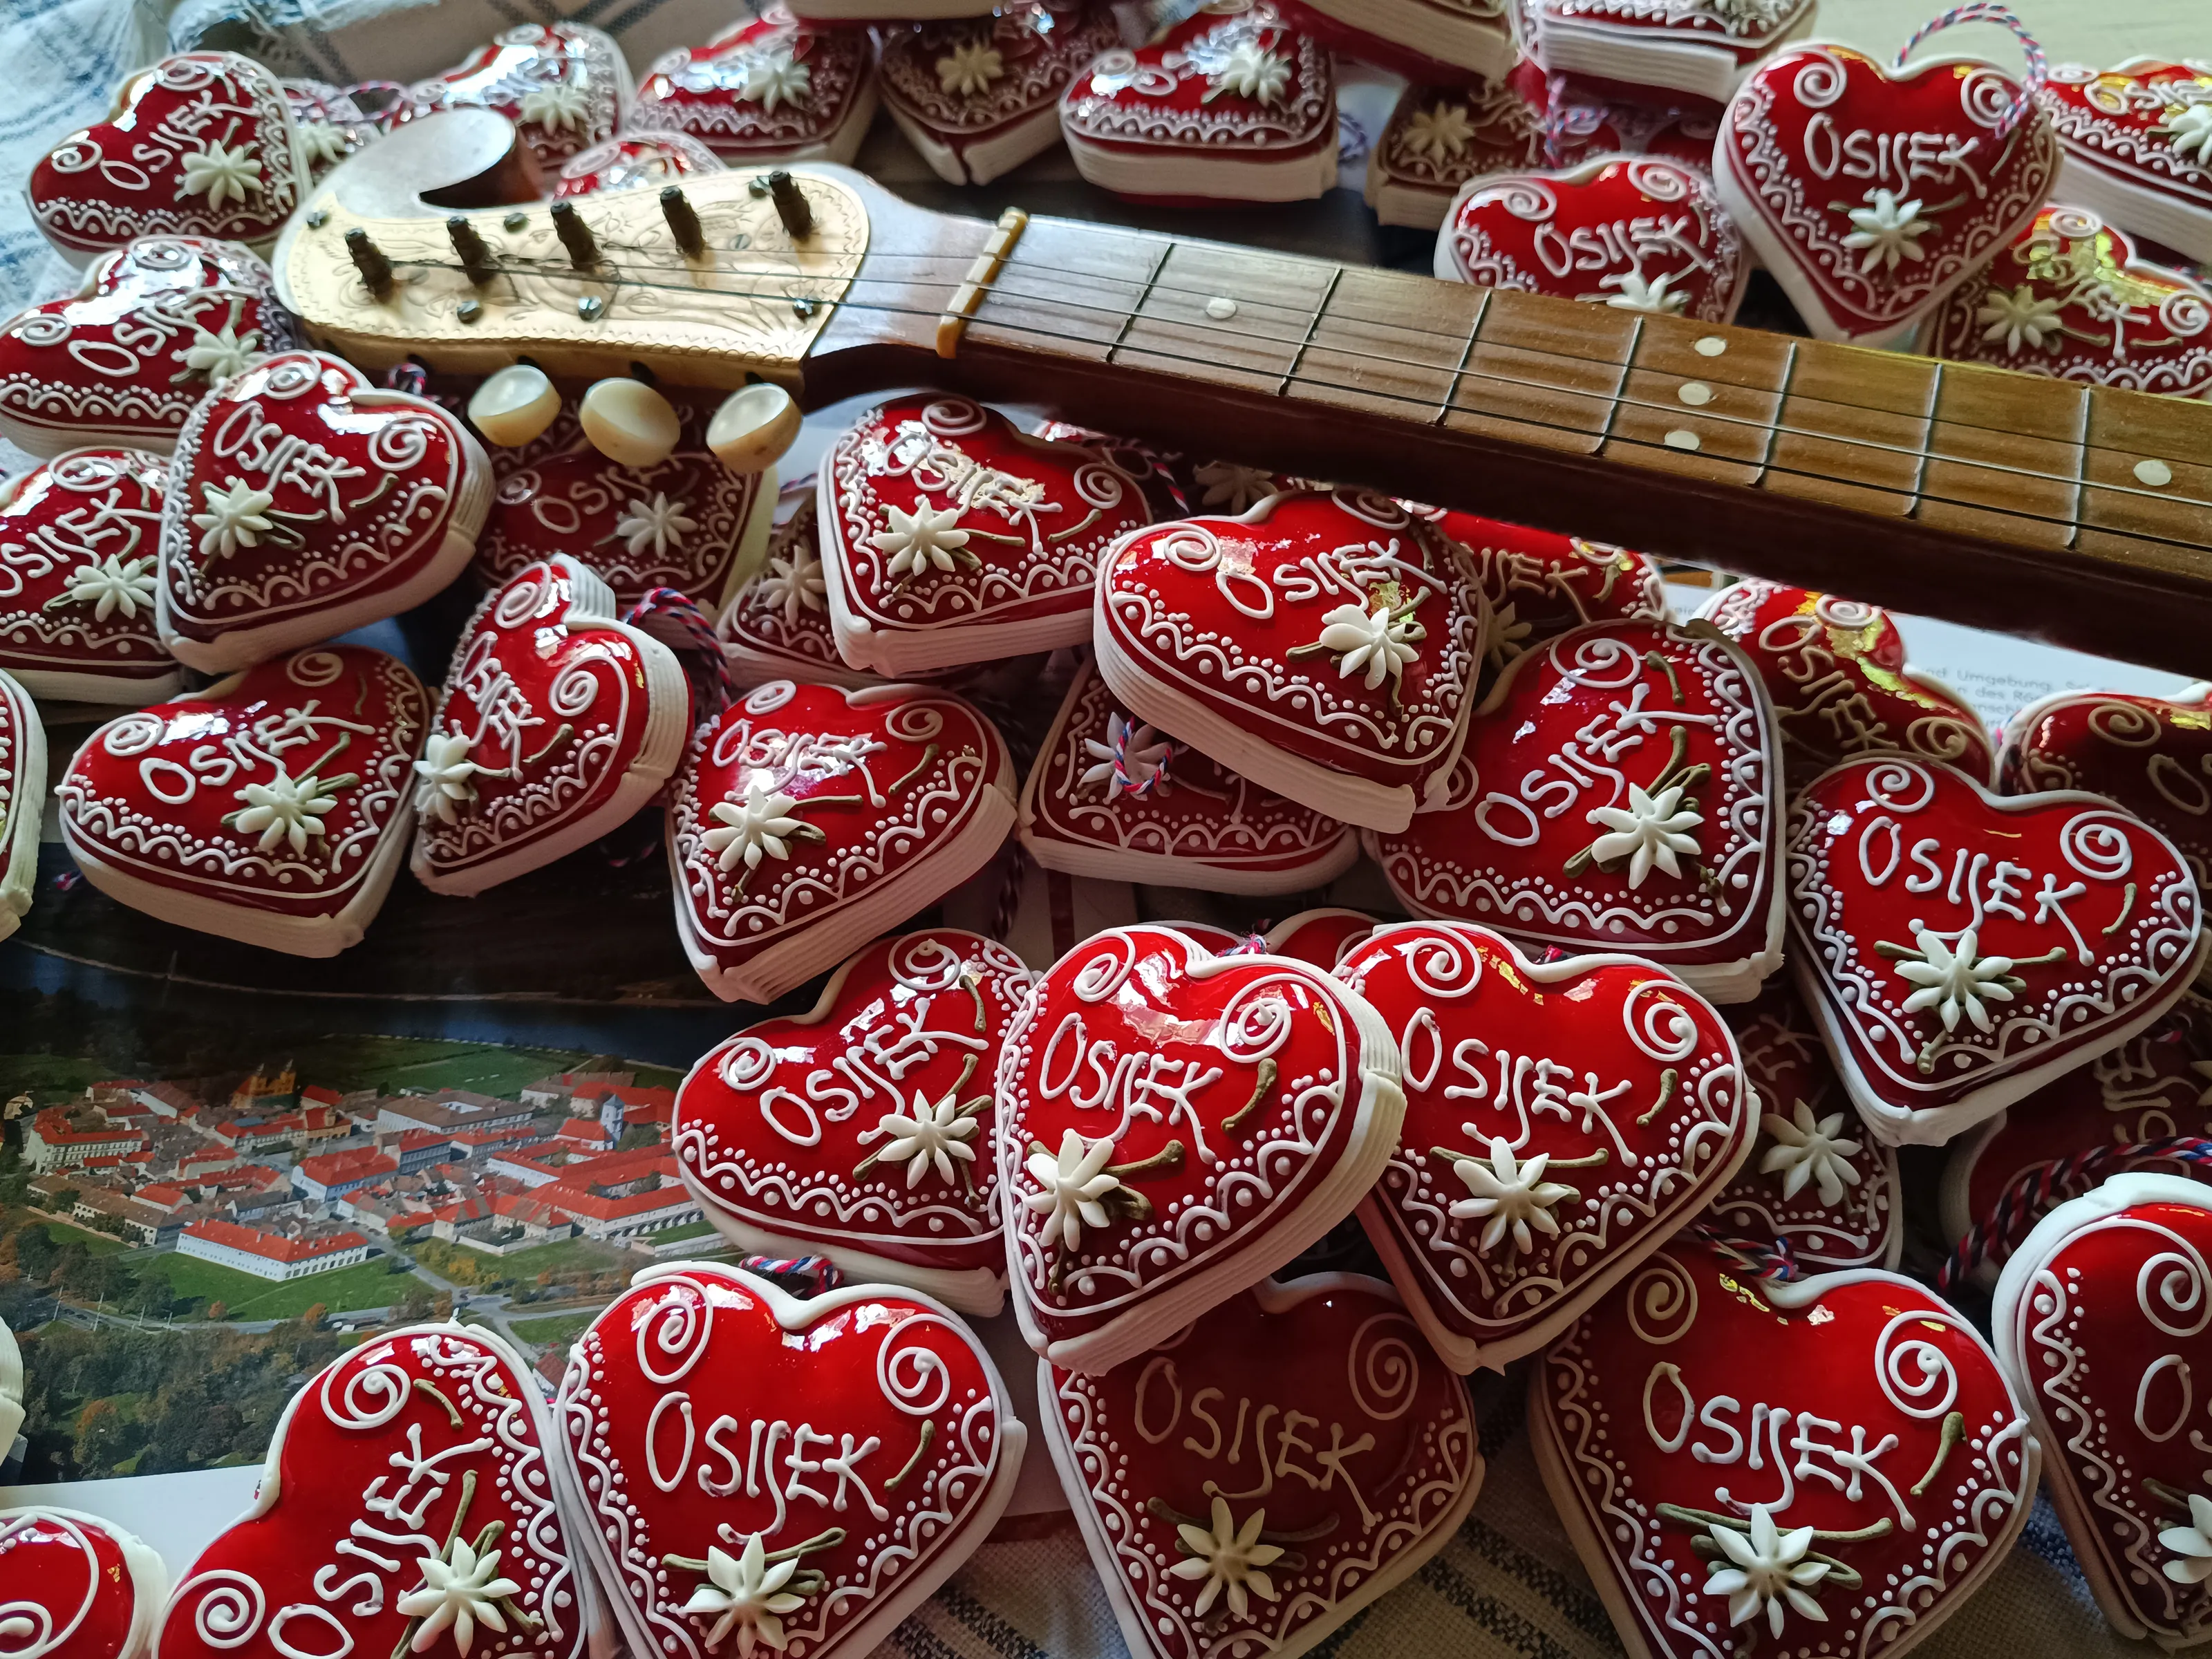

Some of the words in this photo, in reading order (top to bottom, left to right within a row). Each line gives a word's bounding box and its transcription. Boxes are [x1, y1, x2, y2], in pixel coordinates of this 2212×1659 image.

[1803, 112, 1989, 202] OSIJEK
[1534, 216, 1715, 289] OSIJEK
[213, 401, 366, 525] OSIJEK
[883, 431, 1063, 554] OSIJEK
[1215, 538, 1448, 621] OSIJEK
[139, 699, 375, 805] OSIJEK
[712, 718, 888, 808] OSIJEK
[1474, 683, 1719, 847] OSIJEK
[1859, 816, 2094, 966] OSIJEK
[760, 997, 989, 1147] OSIJEK
[1039, 1011, 1224, 1164] OSIJEK
[1402, 1007, 1638, 1166] OSIJEK
[646, 1391, 889, 1544] OSIJEK
[1135, 1357, 1376, 1527] OSIJEK
[1644, 1361, 1917, 1530] OSIJEK
[268, 1423, 494, 1658] OSIJEK
